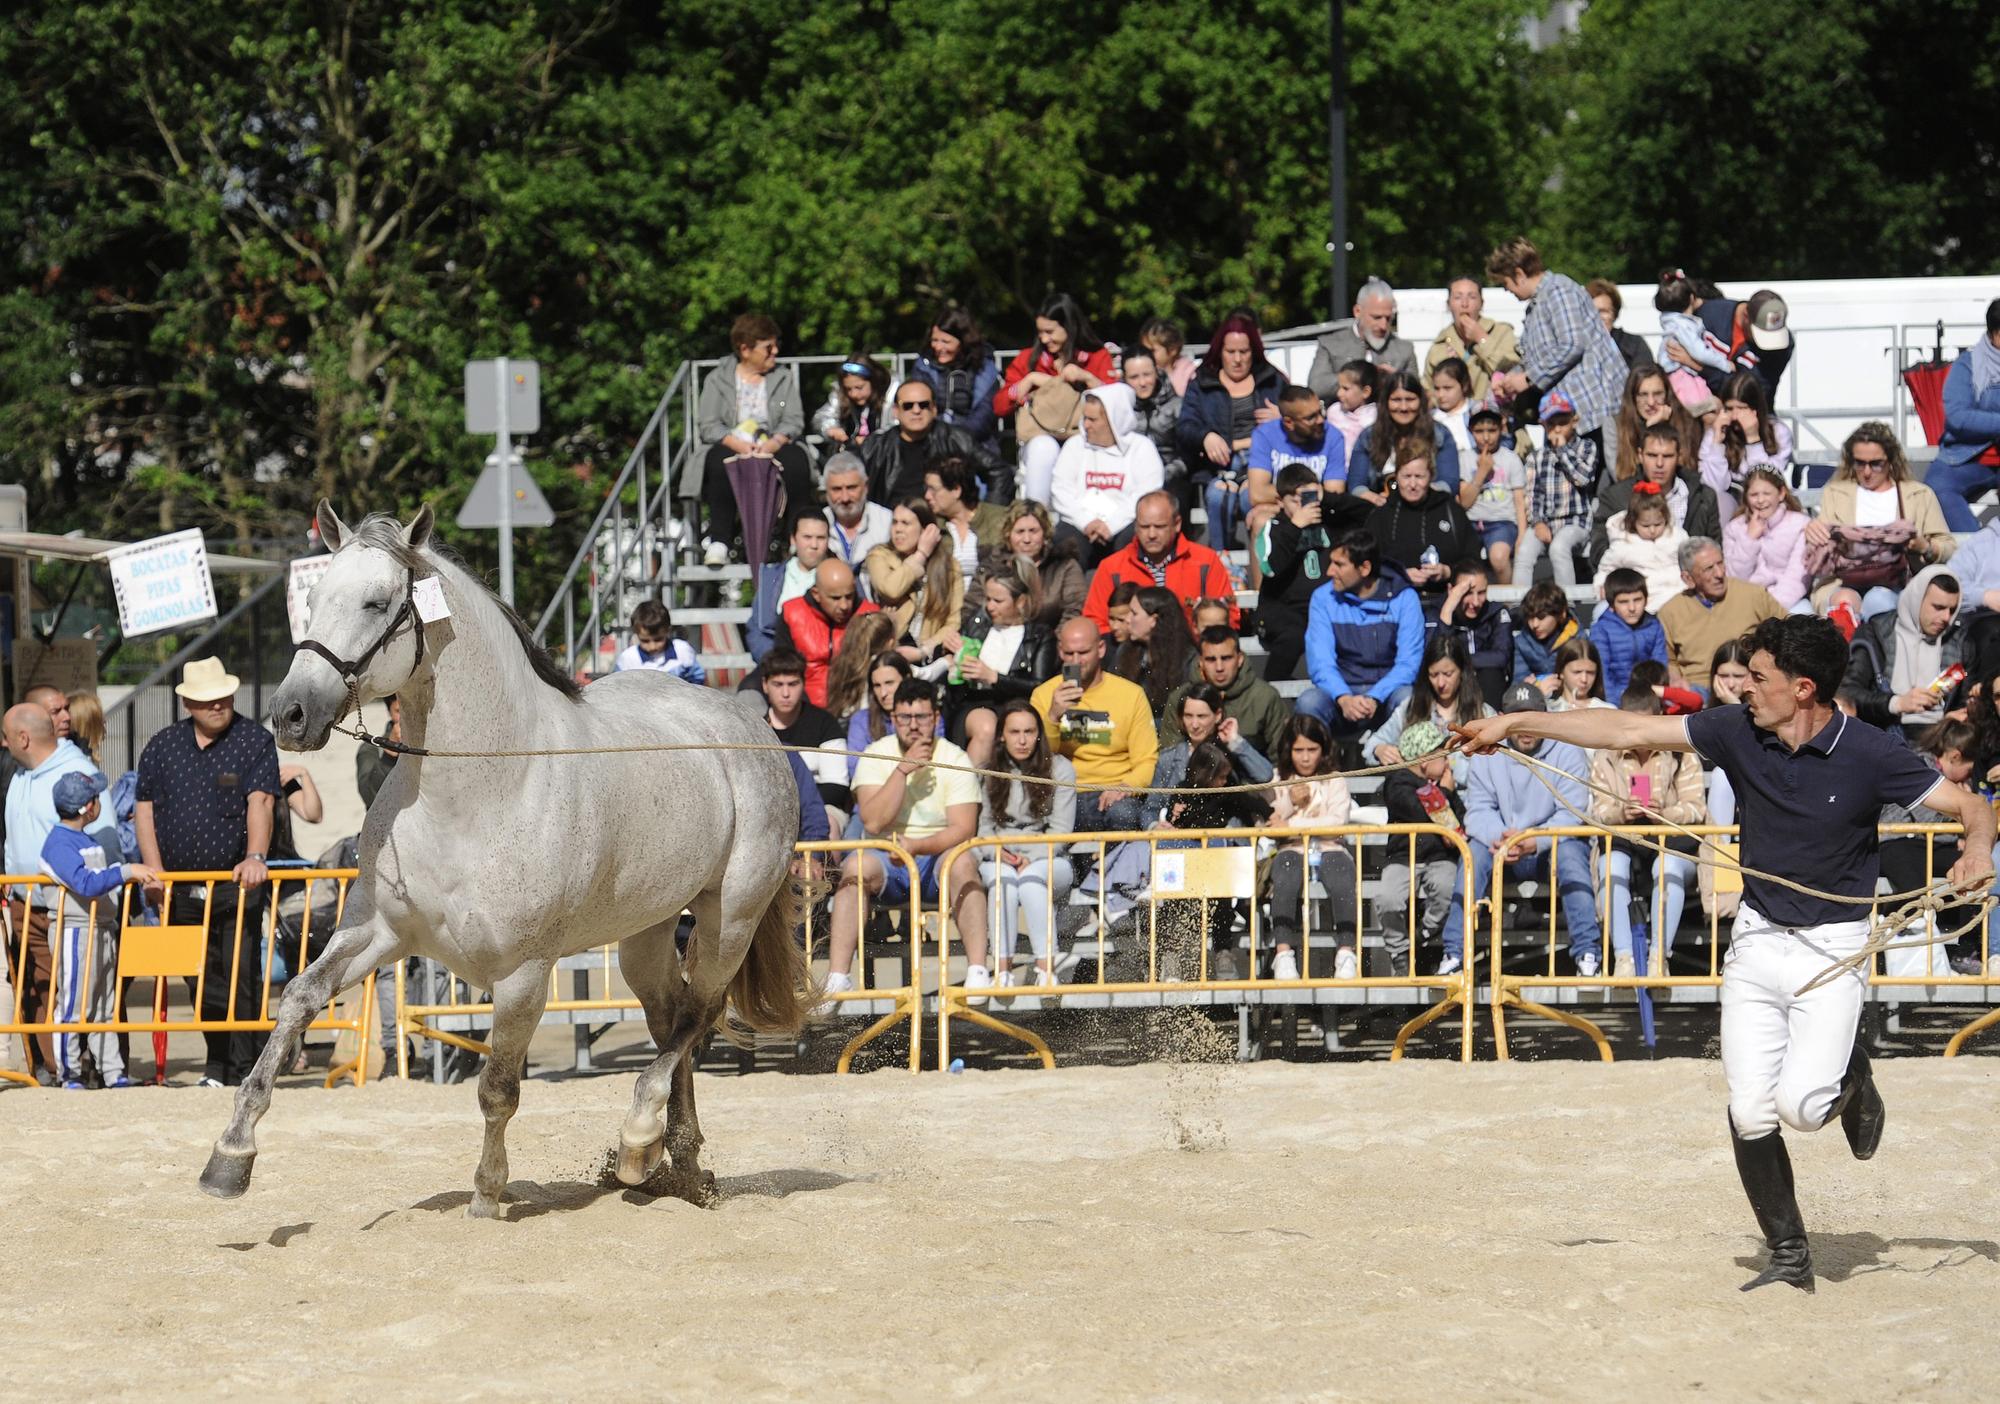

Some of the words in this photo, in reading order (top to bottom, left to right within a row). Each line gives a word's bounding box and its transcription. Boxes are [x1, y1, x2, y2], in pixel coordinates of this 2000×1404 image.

[130, 549, 188, 578] BOCATAS
[147, 577, 182, 599] PIPAS
[134, 596, 204, 627] GOMINOLAS
